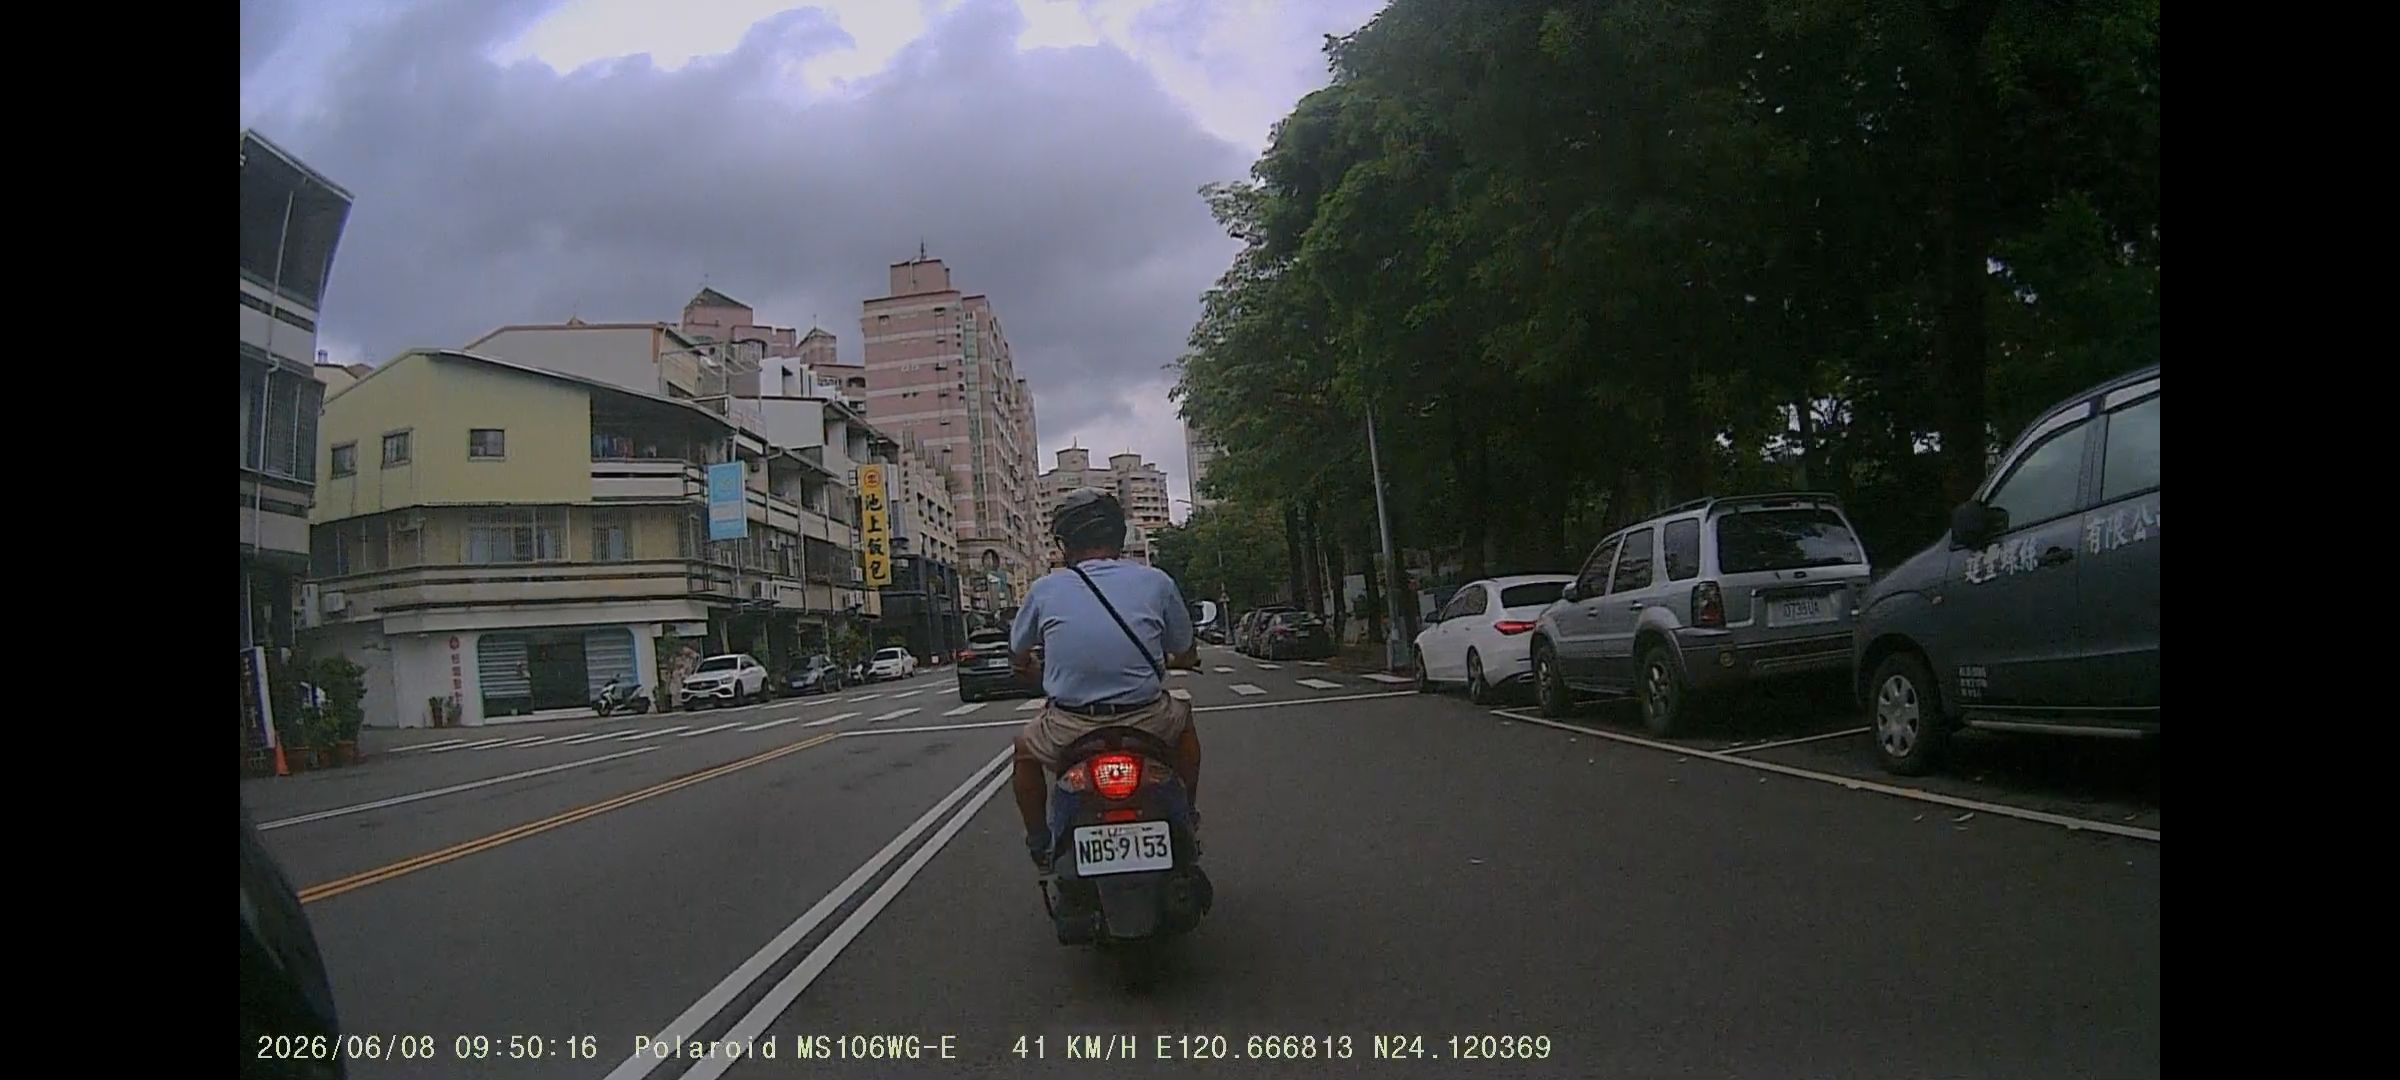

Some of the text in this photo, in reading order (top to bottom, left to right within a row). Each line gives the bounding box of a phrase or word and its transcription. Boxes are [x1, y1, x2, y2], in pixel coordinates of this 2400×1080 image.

[864, 492, 886, 580] 池上飯包
[2086, 503, 2160, 555] 有限公
